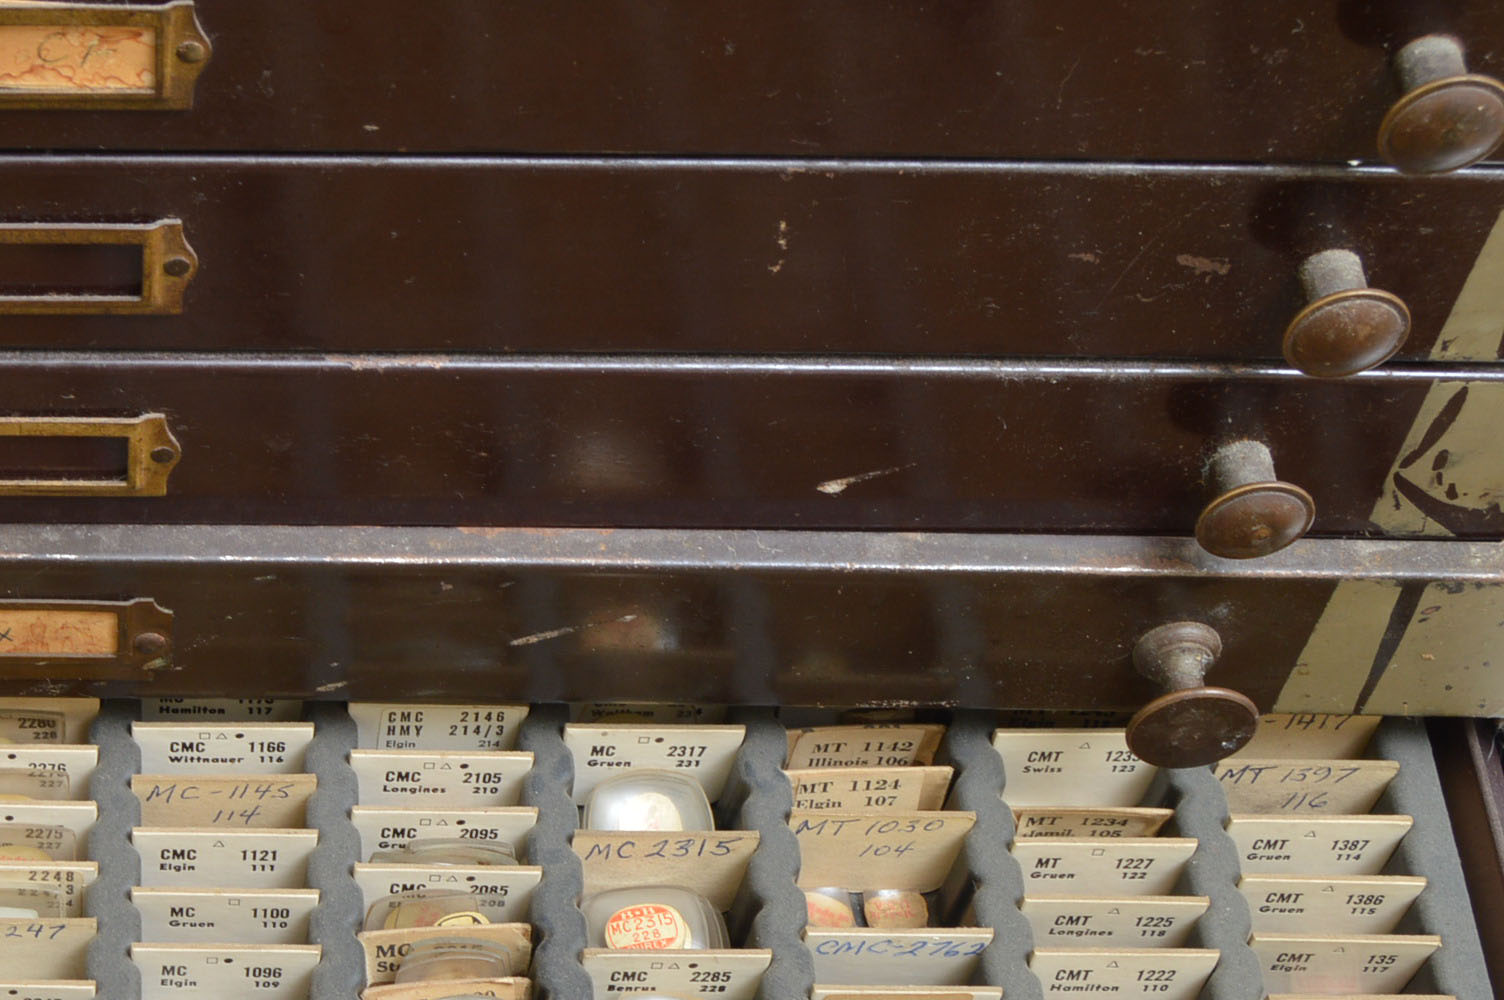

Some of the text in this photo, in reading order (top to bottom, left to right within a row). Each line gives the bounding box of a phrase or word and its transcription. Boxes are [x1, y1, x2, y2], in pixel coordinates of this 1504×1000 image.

[388, 712, 504, 723] CMC 2146
[387, 725, 504, 738] HMY 214/3
[170, 742, 285, 752] CMC 1166
[591, 746, 707, 757] MC 2317
[813, 742, 913, 753] MT 1142
[808, 756, 912, 767] Illinois 106
[386, 771, 501, 784] CMC 2105
[383, 785, 445, 794] Longines
[1252, 839, 1370, 851] CMT 1387
[161, 849, 277, 861] CMC 1121
[1035, 858, 1154, 869] MT 1227
[1265, 893, 1385, 905] CMT 1386
[171, 907, 289, 918] MC 1100
[1055, 970, 1176, 981] CMT 1222
